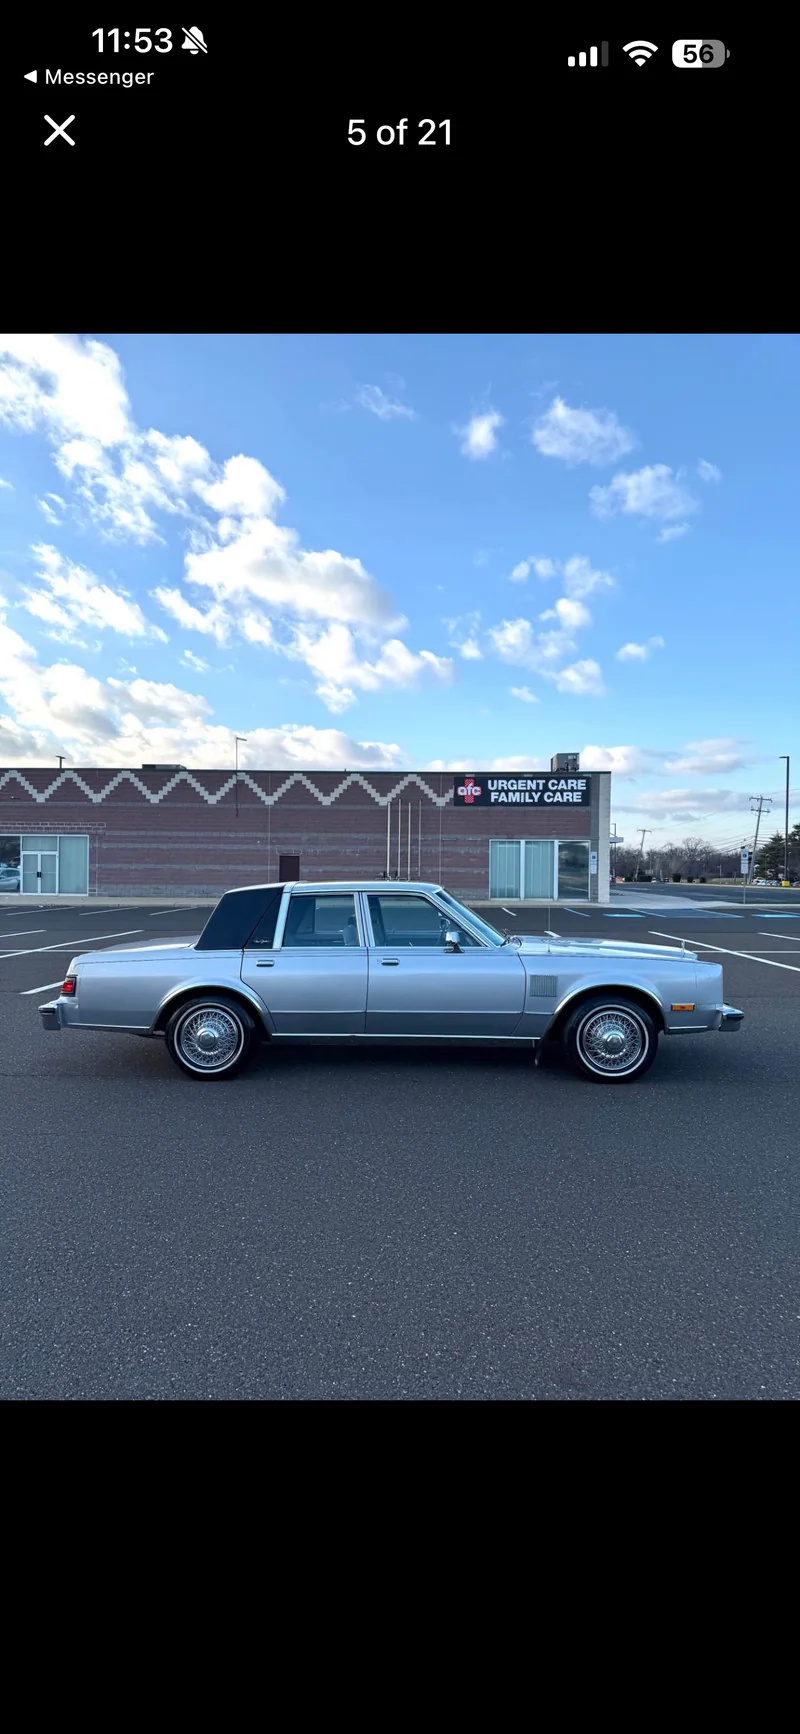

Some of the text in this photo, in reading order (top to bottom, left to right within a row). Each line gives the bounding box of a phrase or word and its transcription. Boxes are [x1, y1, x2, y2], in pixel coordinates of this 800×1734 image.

[457, 783, 481, 796] afc
[487, 779, 586, 790] URGENT CARE
[490, 792, 582, 802] FAMILY CARE
